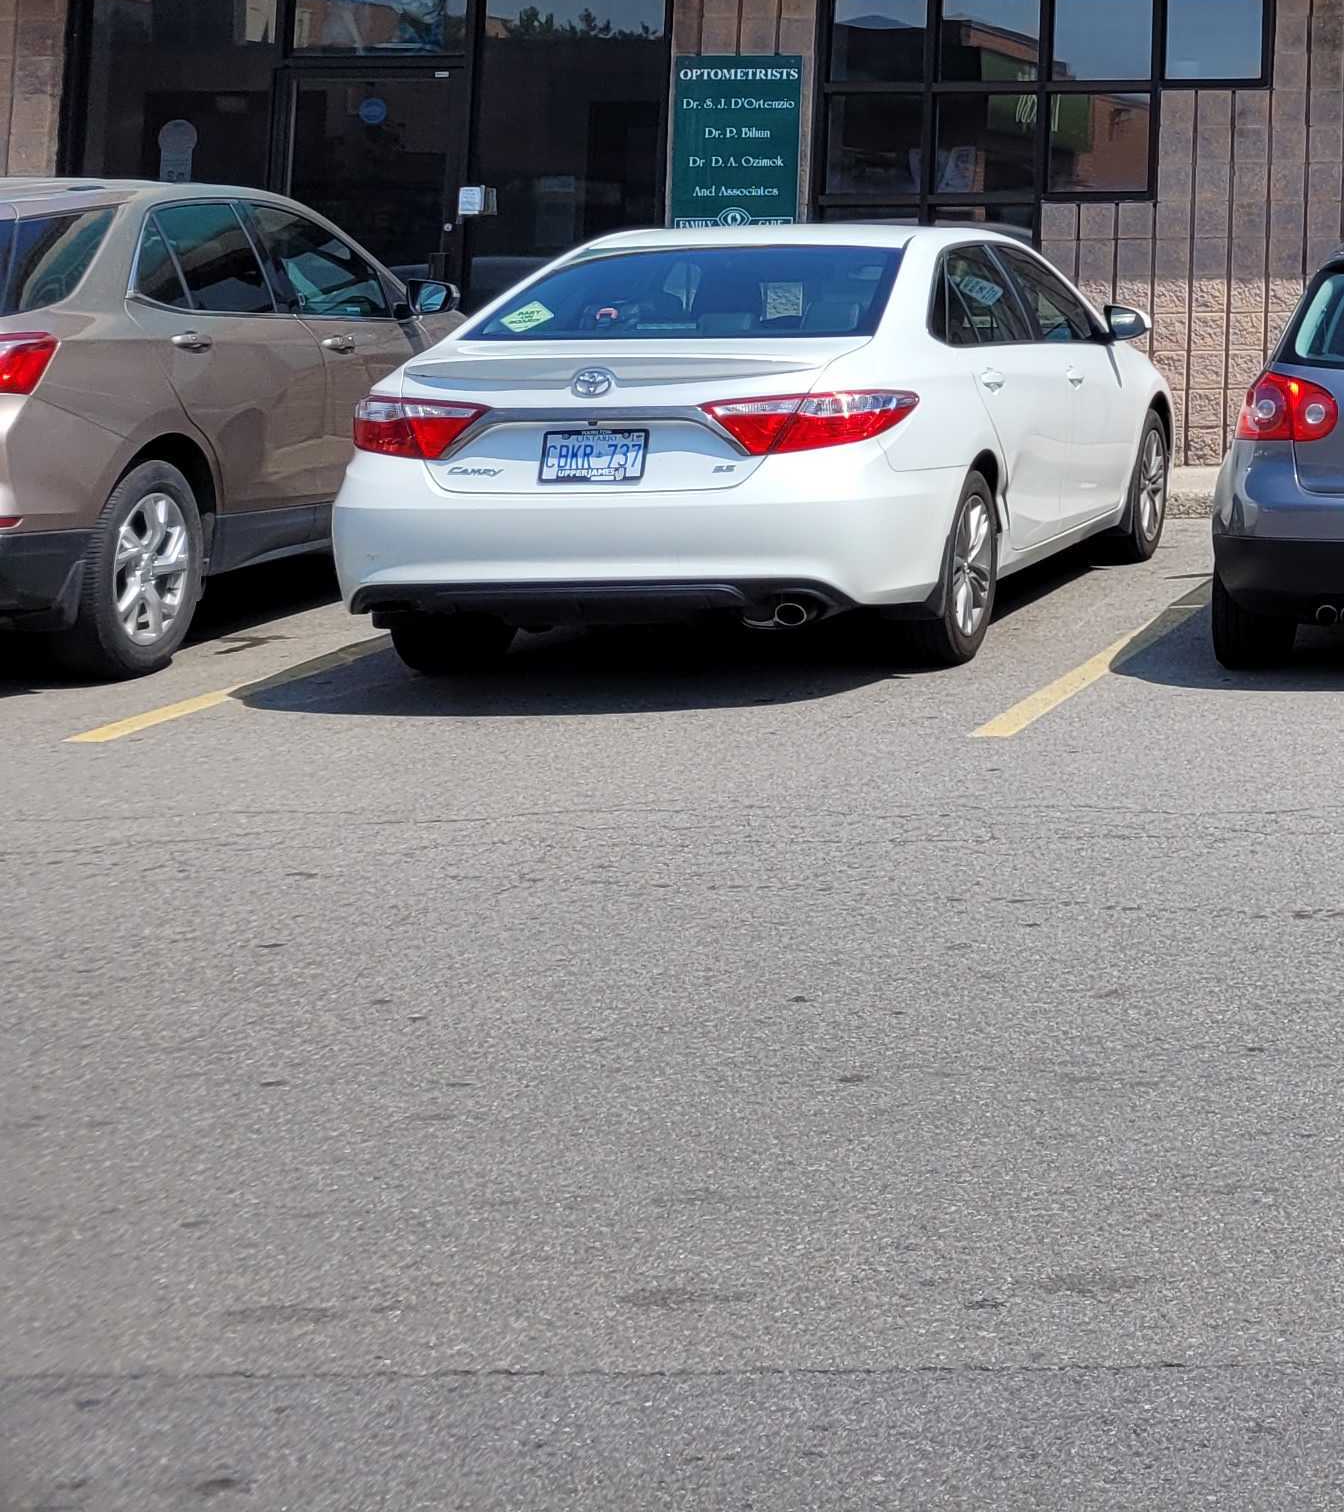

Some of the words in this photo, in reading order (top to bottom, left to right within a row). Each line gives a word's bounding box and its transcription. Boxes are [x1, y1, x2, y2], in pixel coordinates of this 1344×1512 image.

[679, 68, 799, 81] OPTOMETRISTS
[683, 98, 702, 109] Dr.
[705, 127, 723, 139] Dr.
[725, 127, 738, 138] P.
[741, 156, 784, 168] Ozimok
[692, 186, 715, 197] And
[718, 186, 779, 197] Associates
[545, 443, 594, 469] CBKR
[607, 443, 642, 468] 737
